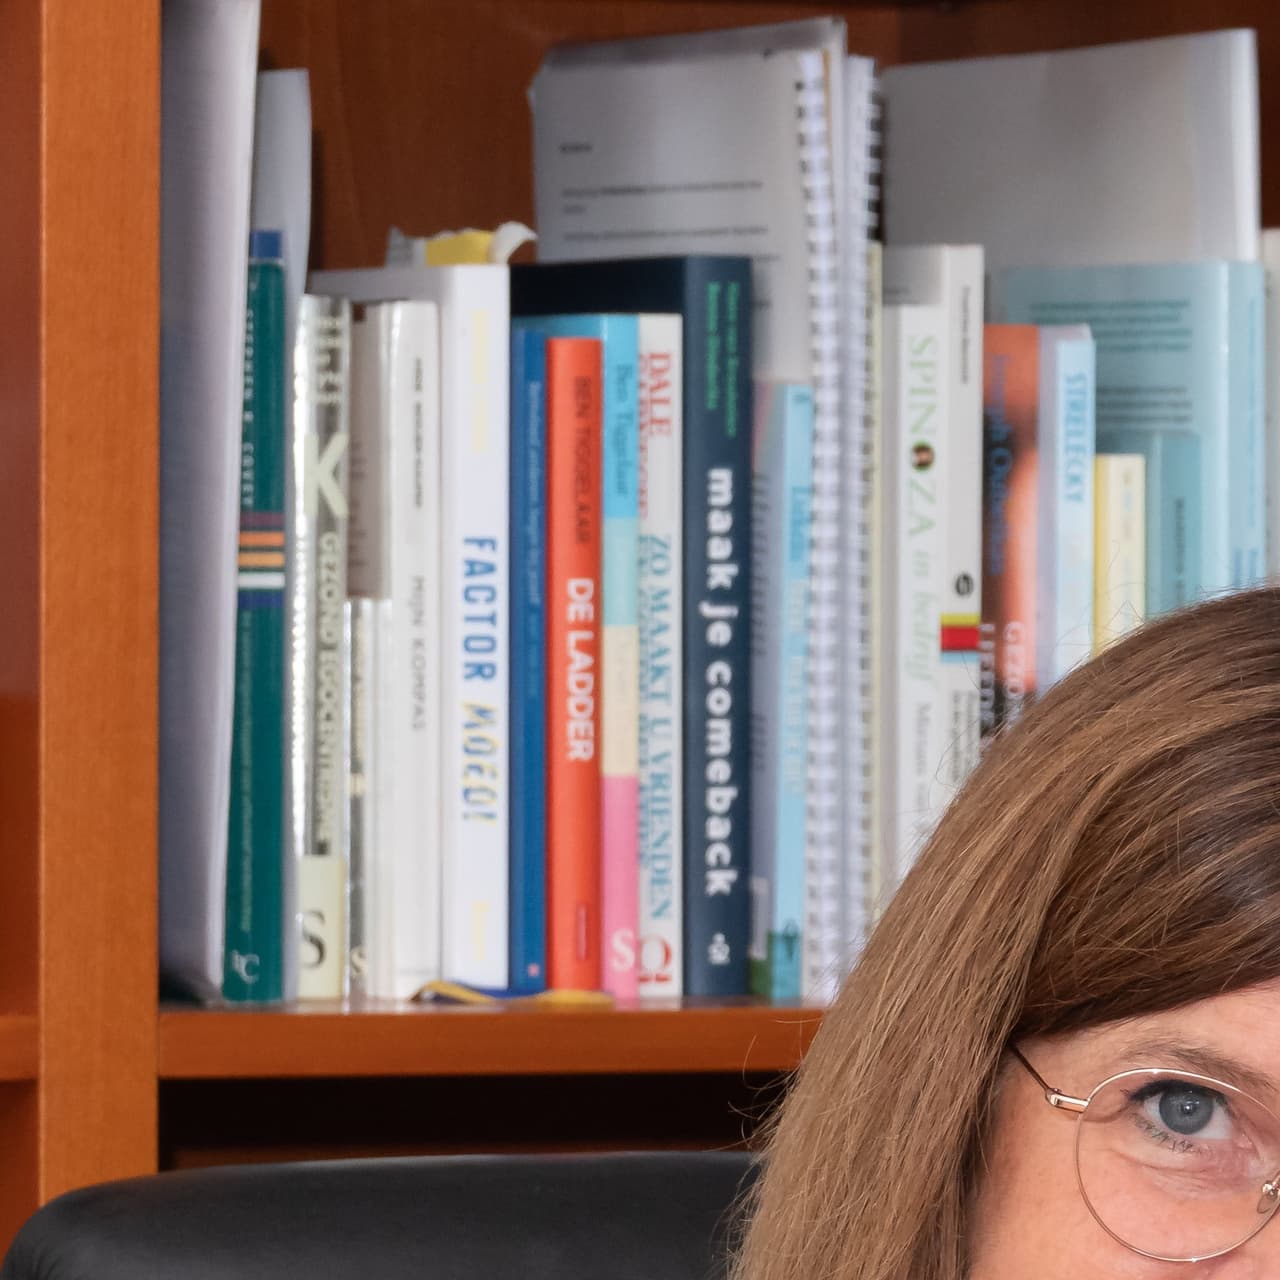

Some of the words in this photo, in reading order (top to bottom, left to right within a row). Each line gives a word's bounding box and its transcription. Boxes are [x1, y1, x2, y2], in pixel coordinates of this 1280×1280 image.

[649, 351, 673, 436] DALE
[649, 534, 672, 574] ZO
[705, 466, 739, 592] maak
[462, 536, 499, 683] FACTOR
[566, 577, 595, 623] DE
[649, 587, 672, 703] MAAKT
[697, 599, 739, 648] je
[565, 630, 594, 763] LADDER
[648, 748, 673, 921] VRIENDEN
[704, 660, 739, 899] comeback
